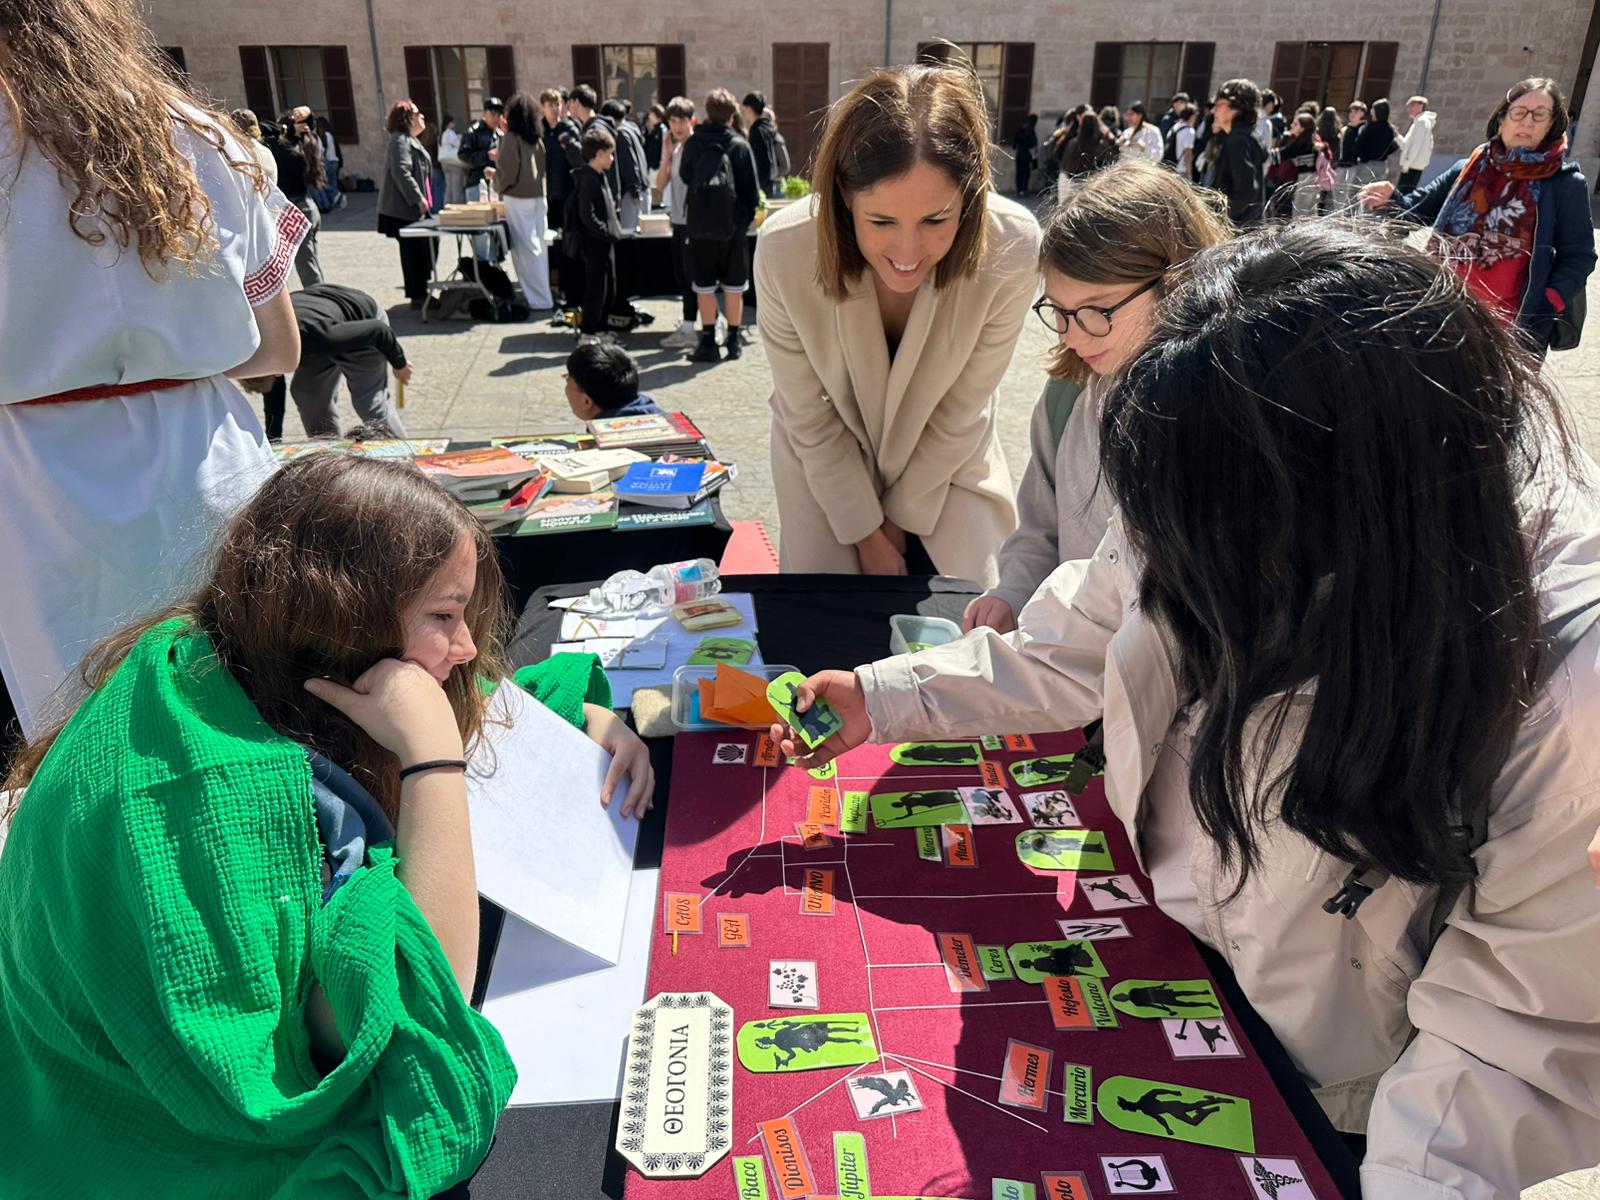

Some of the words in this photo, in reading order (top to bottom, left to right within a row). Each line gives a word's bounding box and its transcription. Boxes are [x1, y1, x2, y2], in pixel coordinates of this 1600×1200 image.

[819, 788, 831, 819] Poseidón
[846, 795, 863, 825] Neptuno
[808, 871, 824, 911] URANO
[676, 898, 692, 926] CAOS
[724, 919, 743, 940] GEA
[990, 949, 1006, 974] Ceres
[1058, 979, 1080, 1017] Hefesto
[1087, 982, 1112, 1026] Vulcano
[662, 1023, 690, 1135] ΘΕΟΓΟΝΙΑ
[1016, 1053, 1040, 1097] Hermes
[1069, 1066, 1088, 1120] Mercurio
[774, 1128, 805, 1191] Dionisos
[841, 1148, 865, 1200] Júpiter
[742, 1162, 760, 1200] Baco
